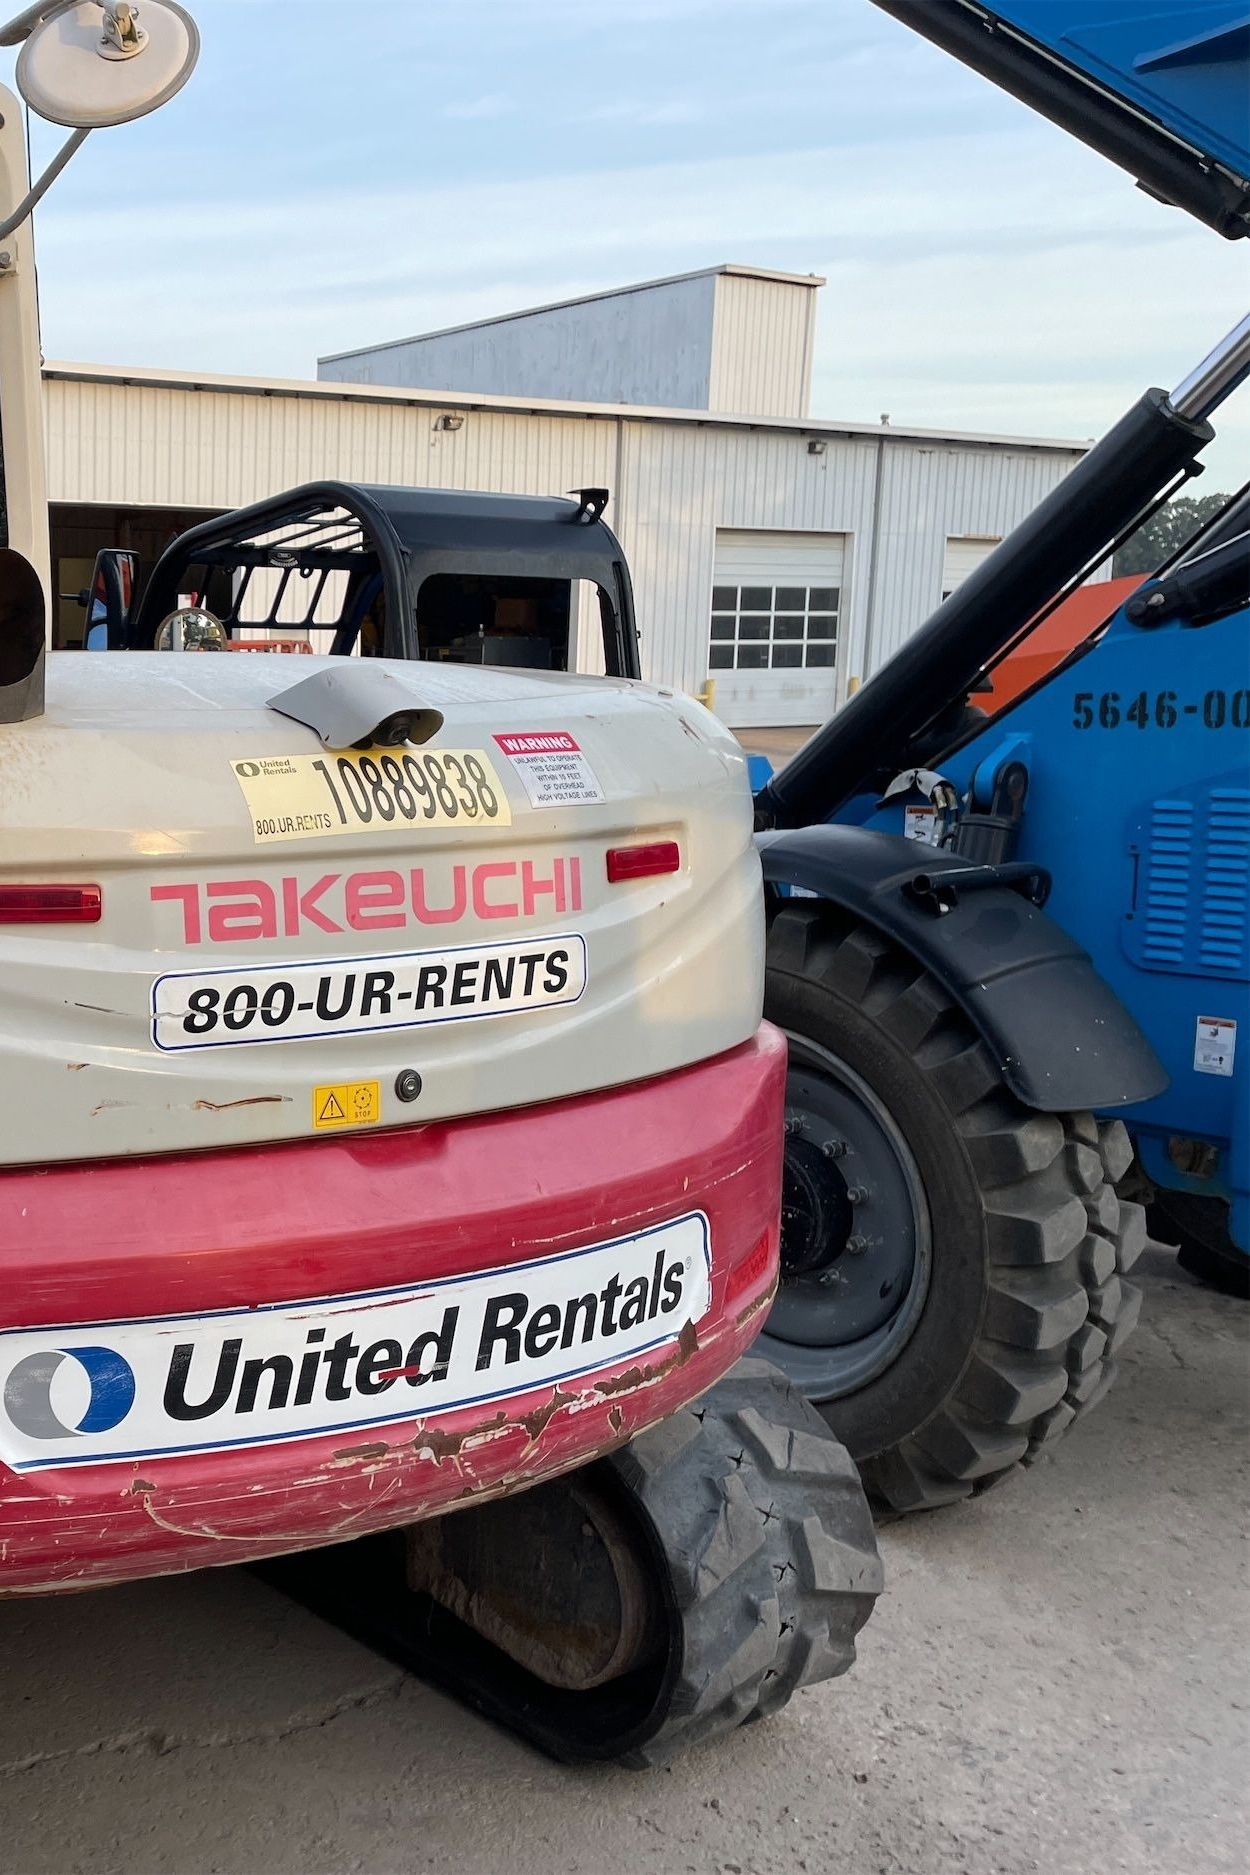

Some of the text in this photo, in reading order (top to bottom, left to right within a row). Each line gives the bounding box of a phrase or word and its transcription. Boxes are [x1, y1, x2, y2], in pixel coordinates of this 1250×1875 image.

[502, 736, 572, 751] WARNING
[259, 760, 290, 768] United
[263, 767, 297, 776] Rentals
[312, 754, 499, 824] 10889838
[554, 782, 584, 790] OVERHEAD
[553, 792, 580, 800] VOLTAGE
[255, 813, 332, 836] 800.UR.RENTS
[182, 950, 569, 1034] 800-UR-RENTS
[163, 1307, 460, 1421] United
